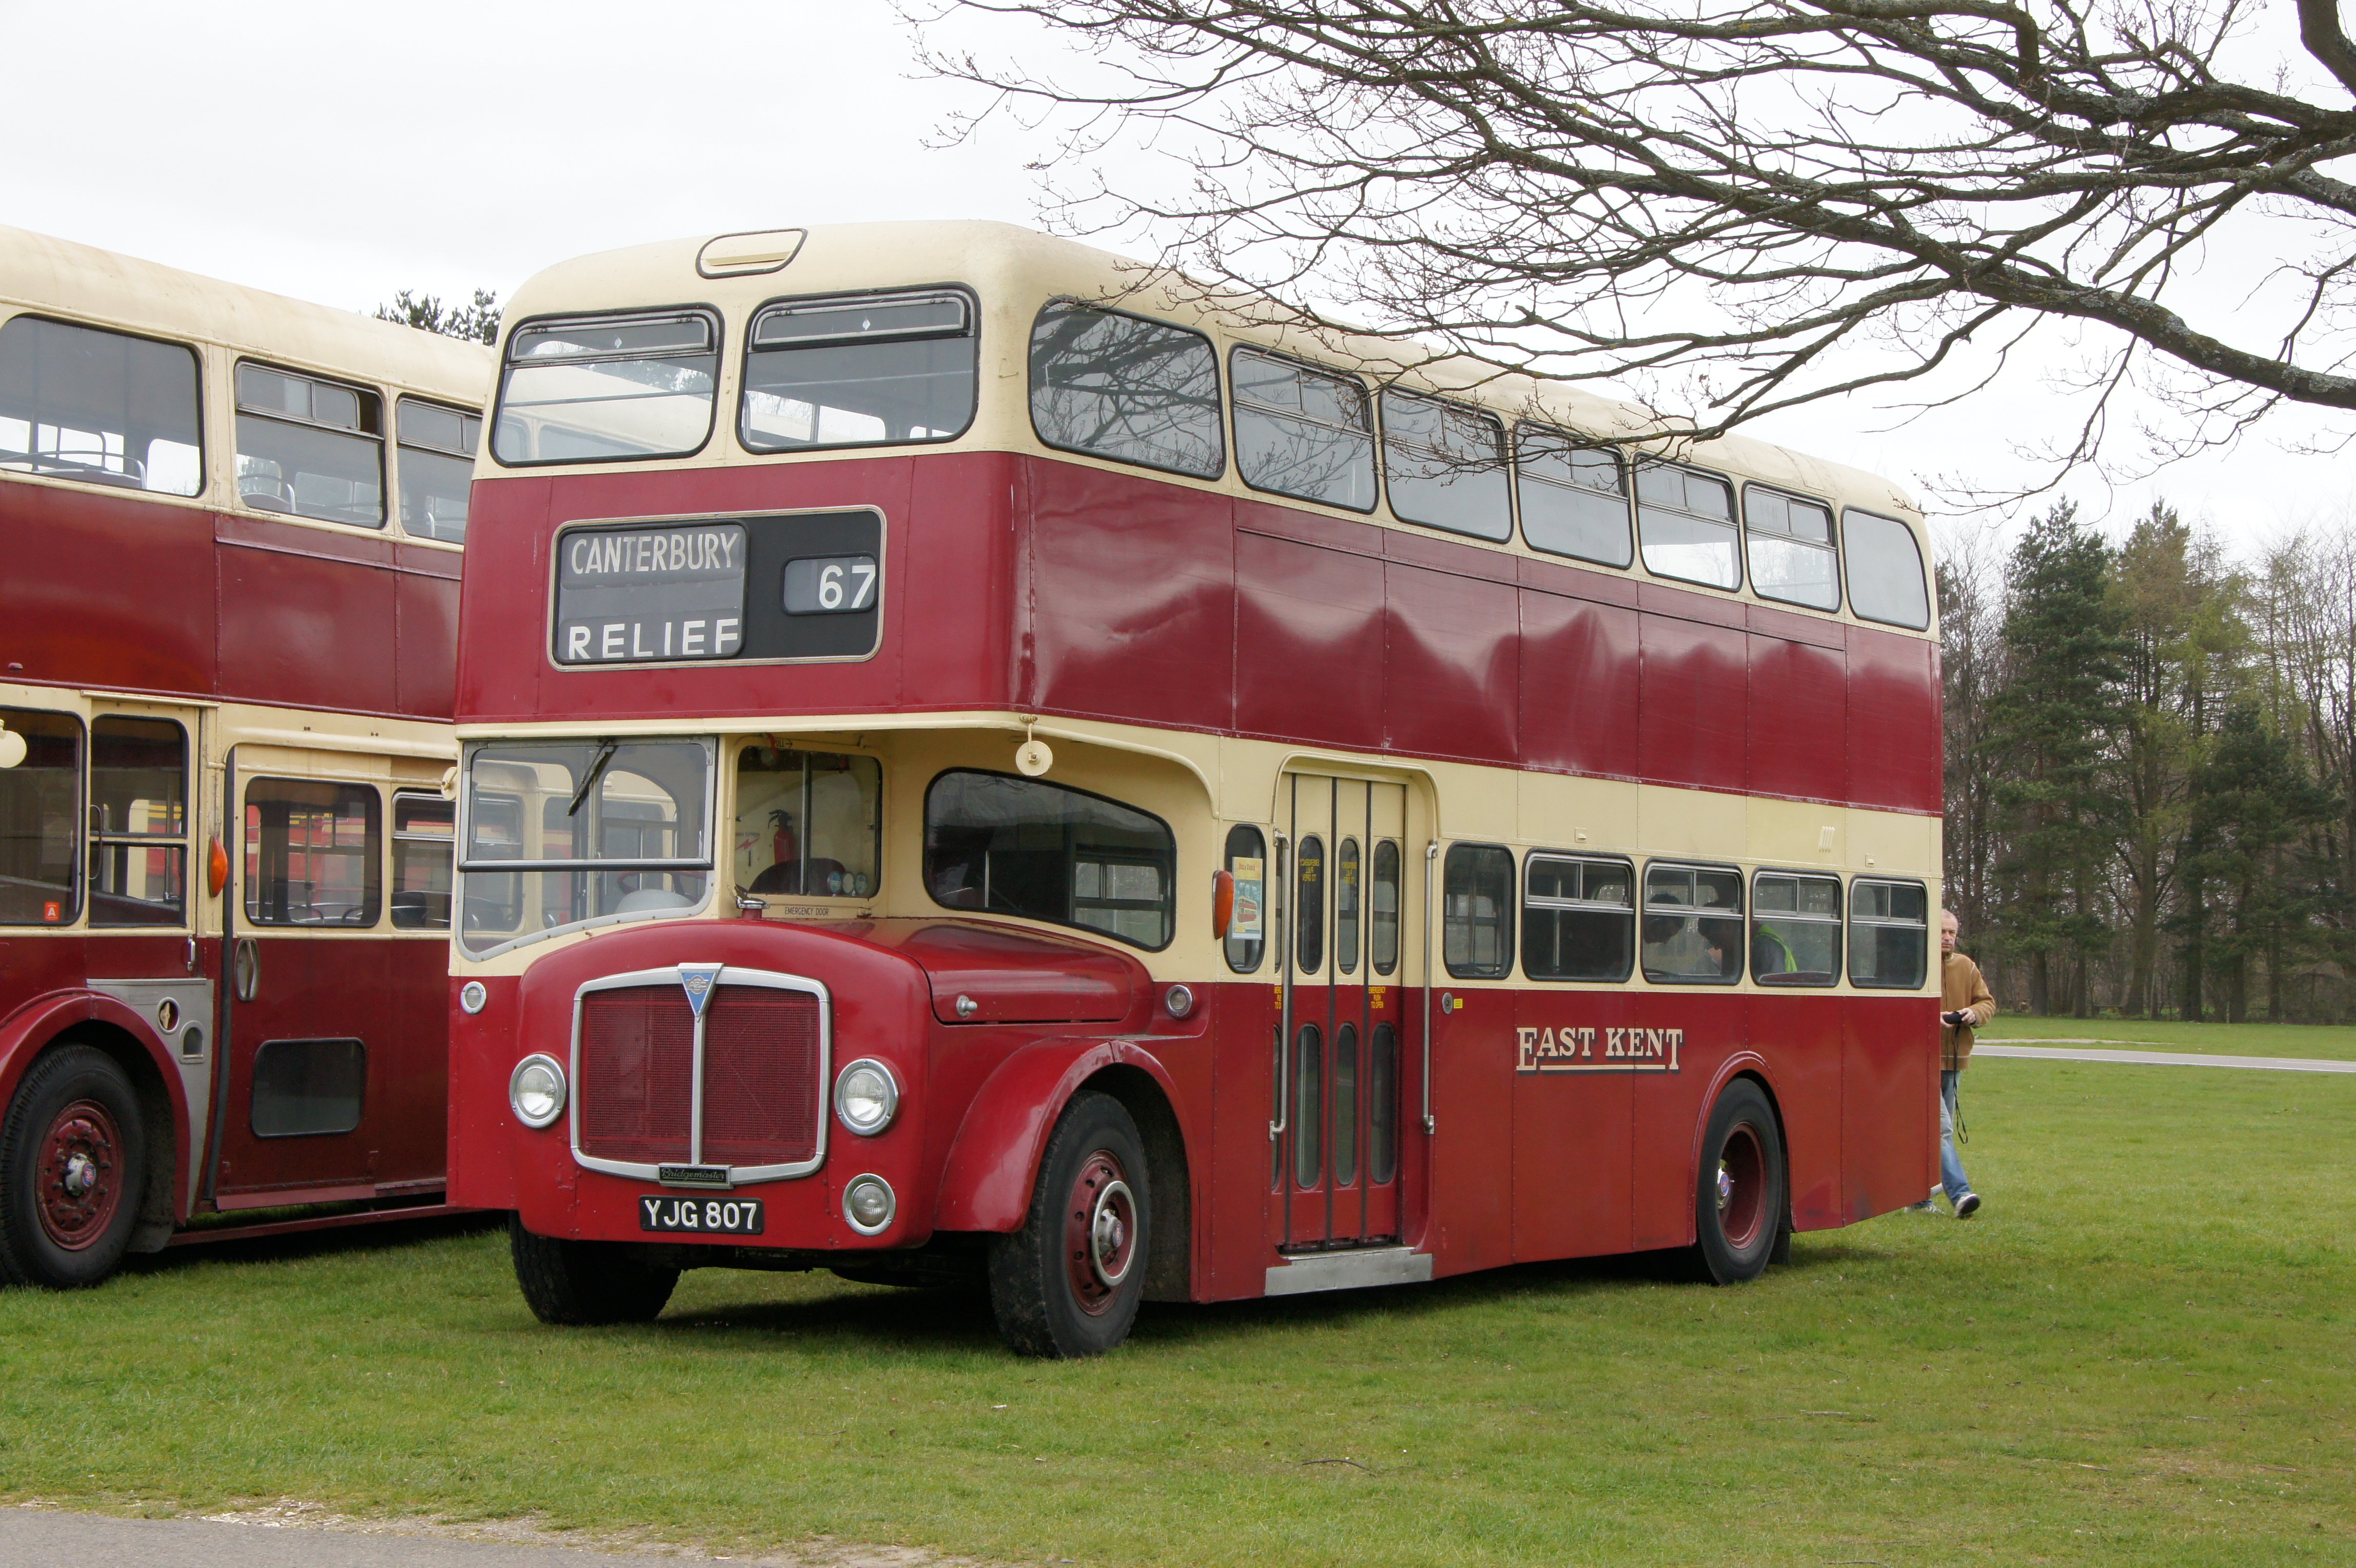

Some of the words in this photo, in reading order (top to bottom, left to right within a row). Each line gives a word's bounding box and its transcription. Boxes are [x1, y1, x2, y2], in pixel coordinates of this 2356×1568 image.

[571, 532, 739, 575] CANTERBURY
[818, 564, 876, 609] 67
[568, 618, 739, 660] RELIEF
[47, 907, 56, 916] A
[784, 907, 814, 915] EMERGENCY
[689, 981, 707, 989] AEC
[1516, 1027, 1595, 1071] EAST
[1605, 1028, 1683, 1071] KENT
[661, 1167, 724, 1180] Bridgemaster
[644, 1200, 698, 1228] YJG
[705, 1202, 757, 1230] 807
